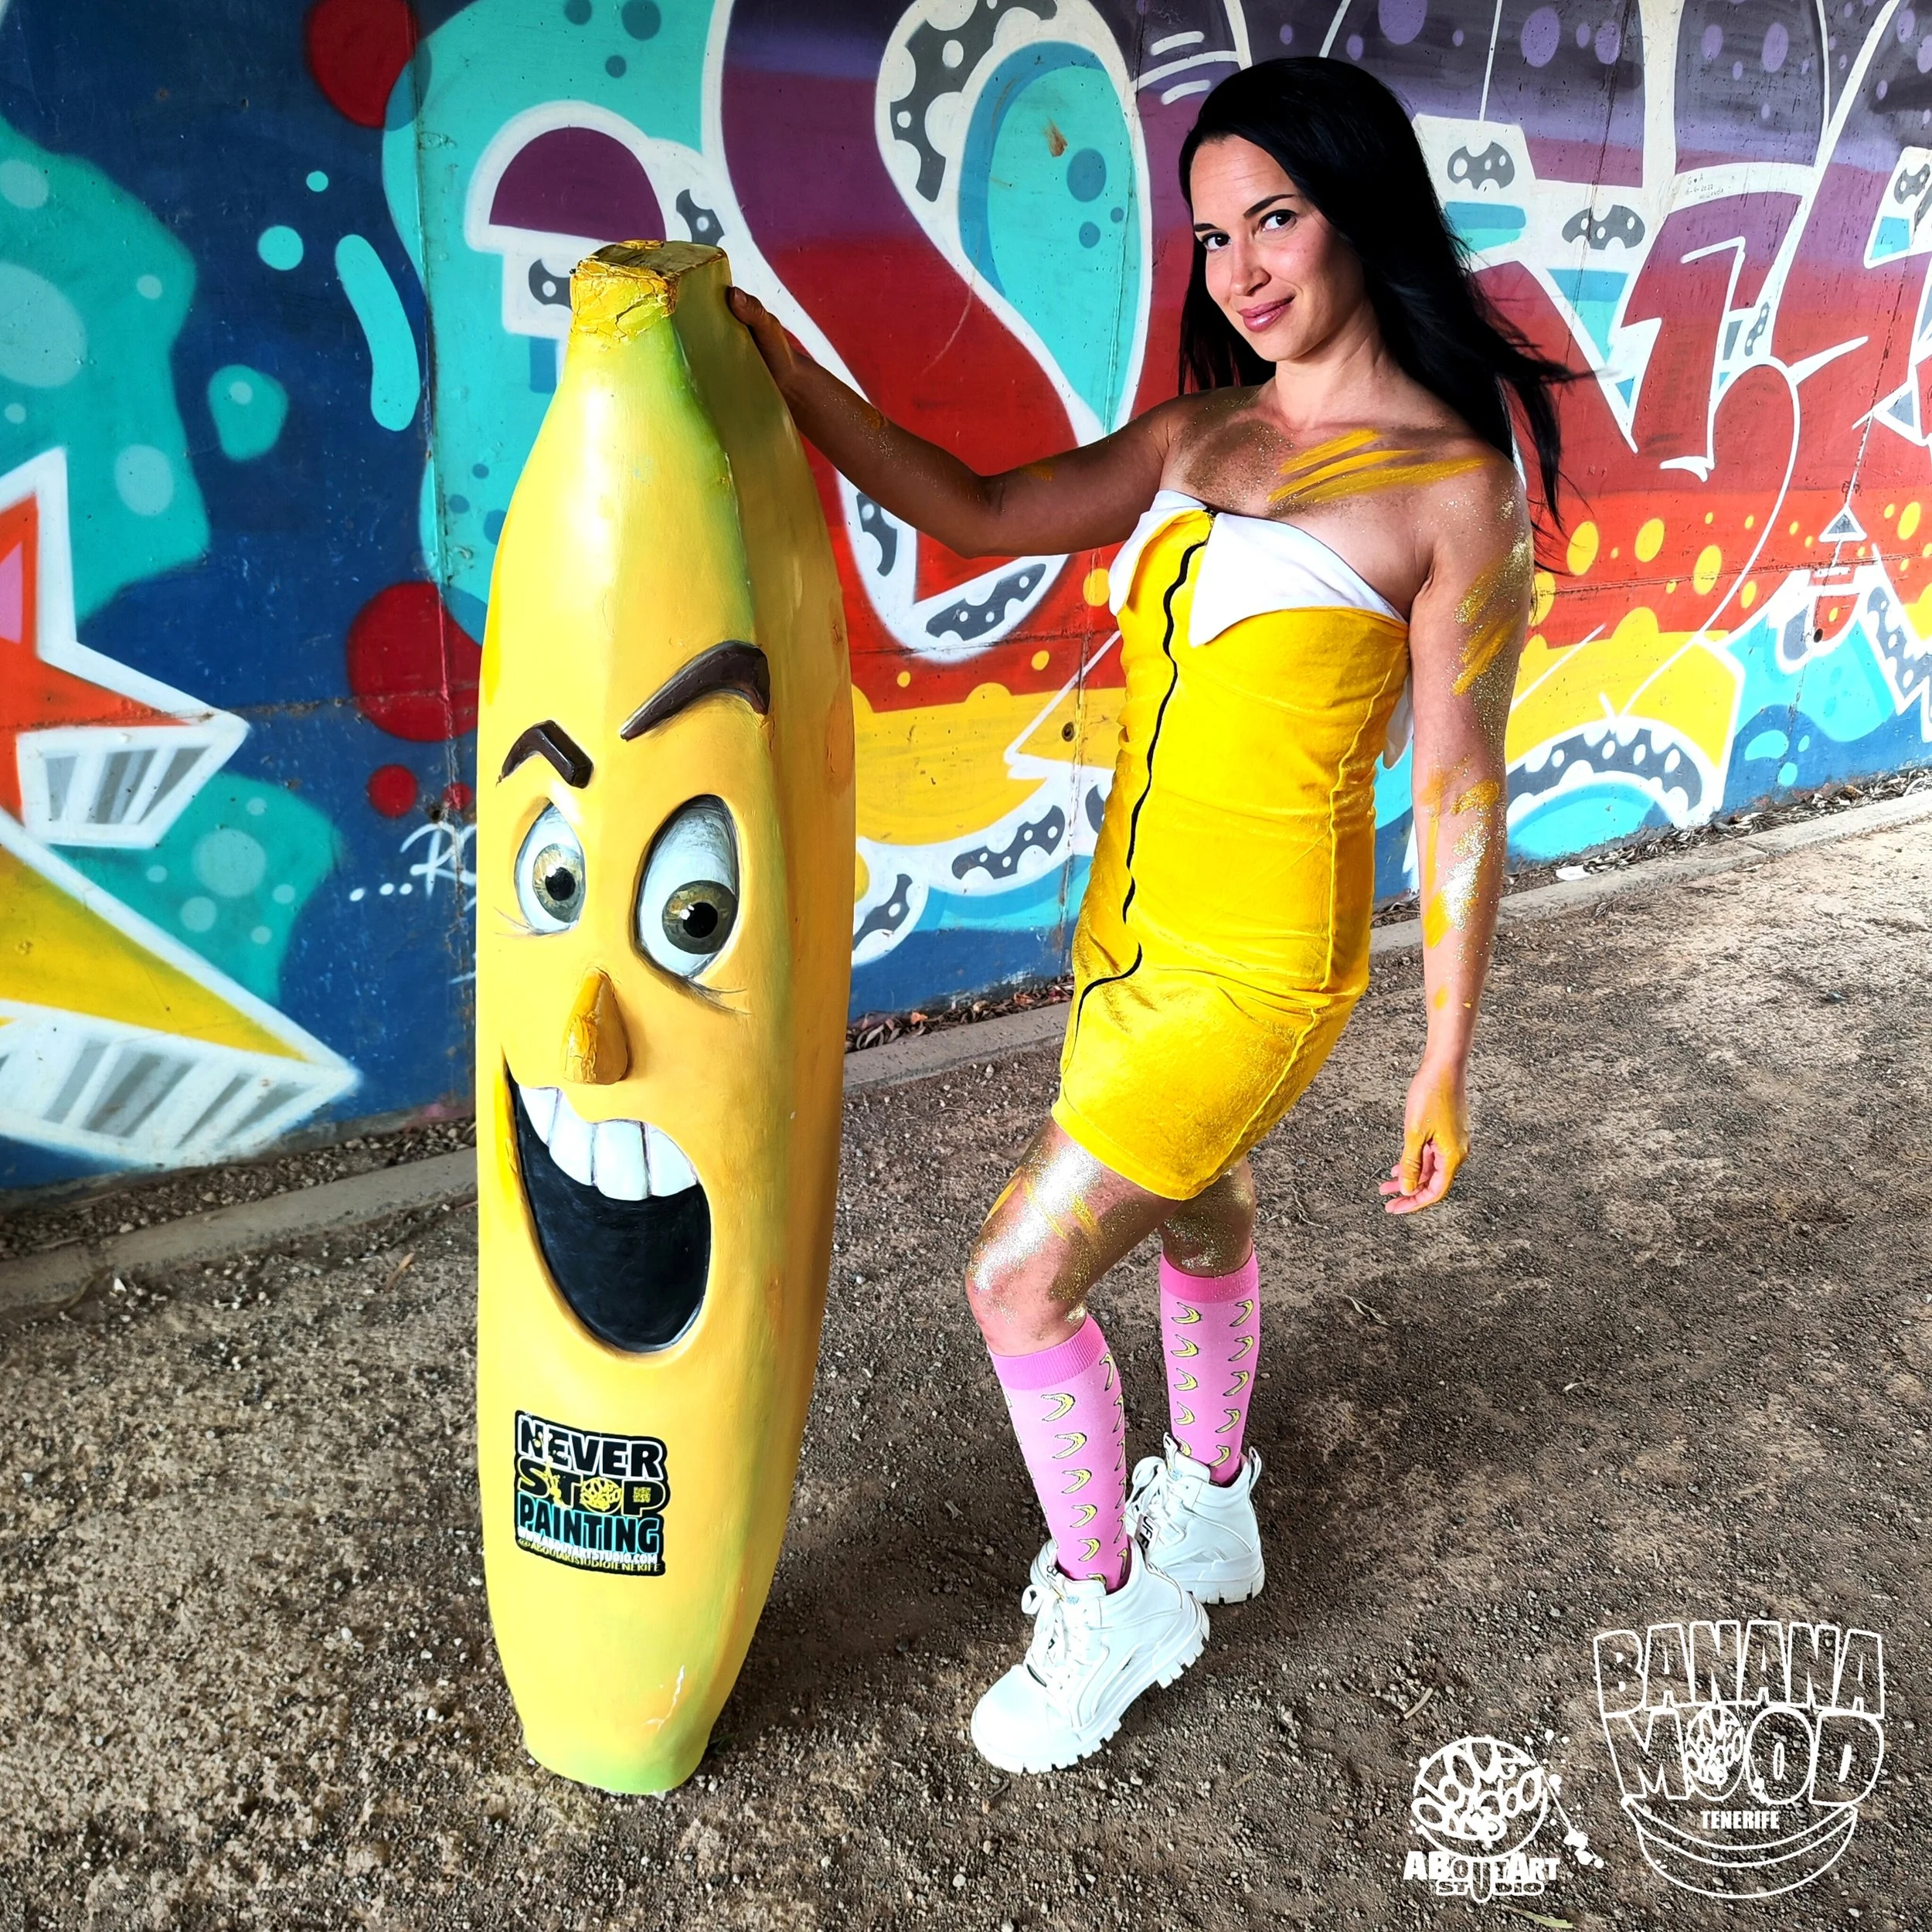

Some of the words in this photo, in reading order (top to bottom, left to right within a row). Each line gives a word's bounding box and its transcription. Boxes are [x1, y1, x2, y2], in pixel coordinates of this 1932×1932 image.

[518, 1413, 664, 1480] NEVER
[517, 1457, 666, 1517] STOP
[517, 1492, 660, 1554] PAINTING
